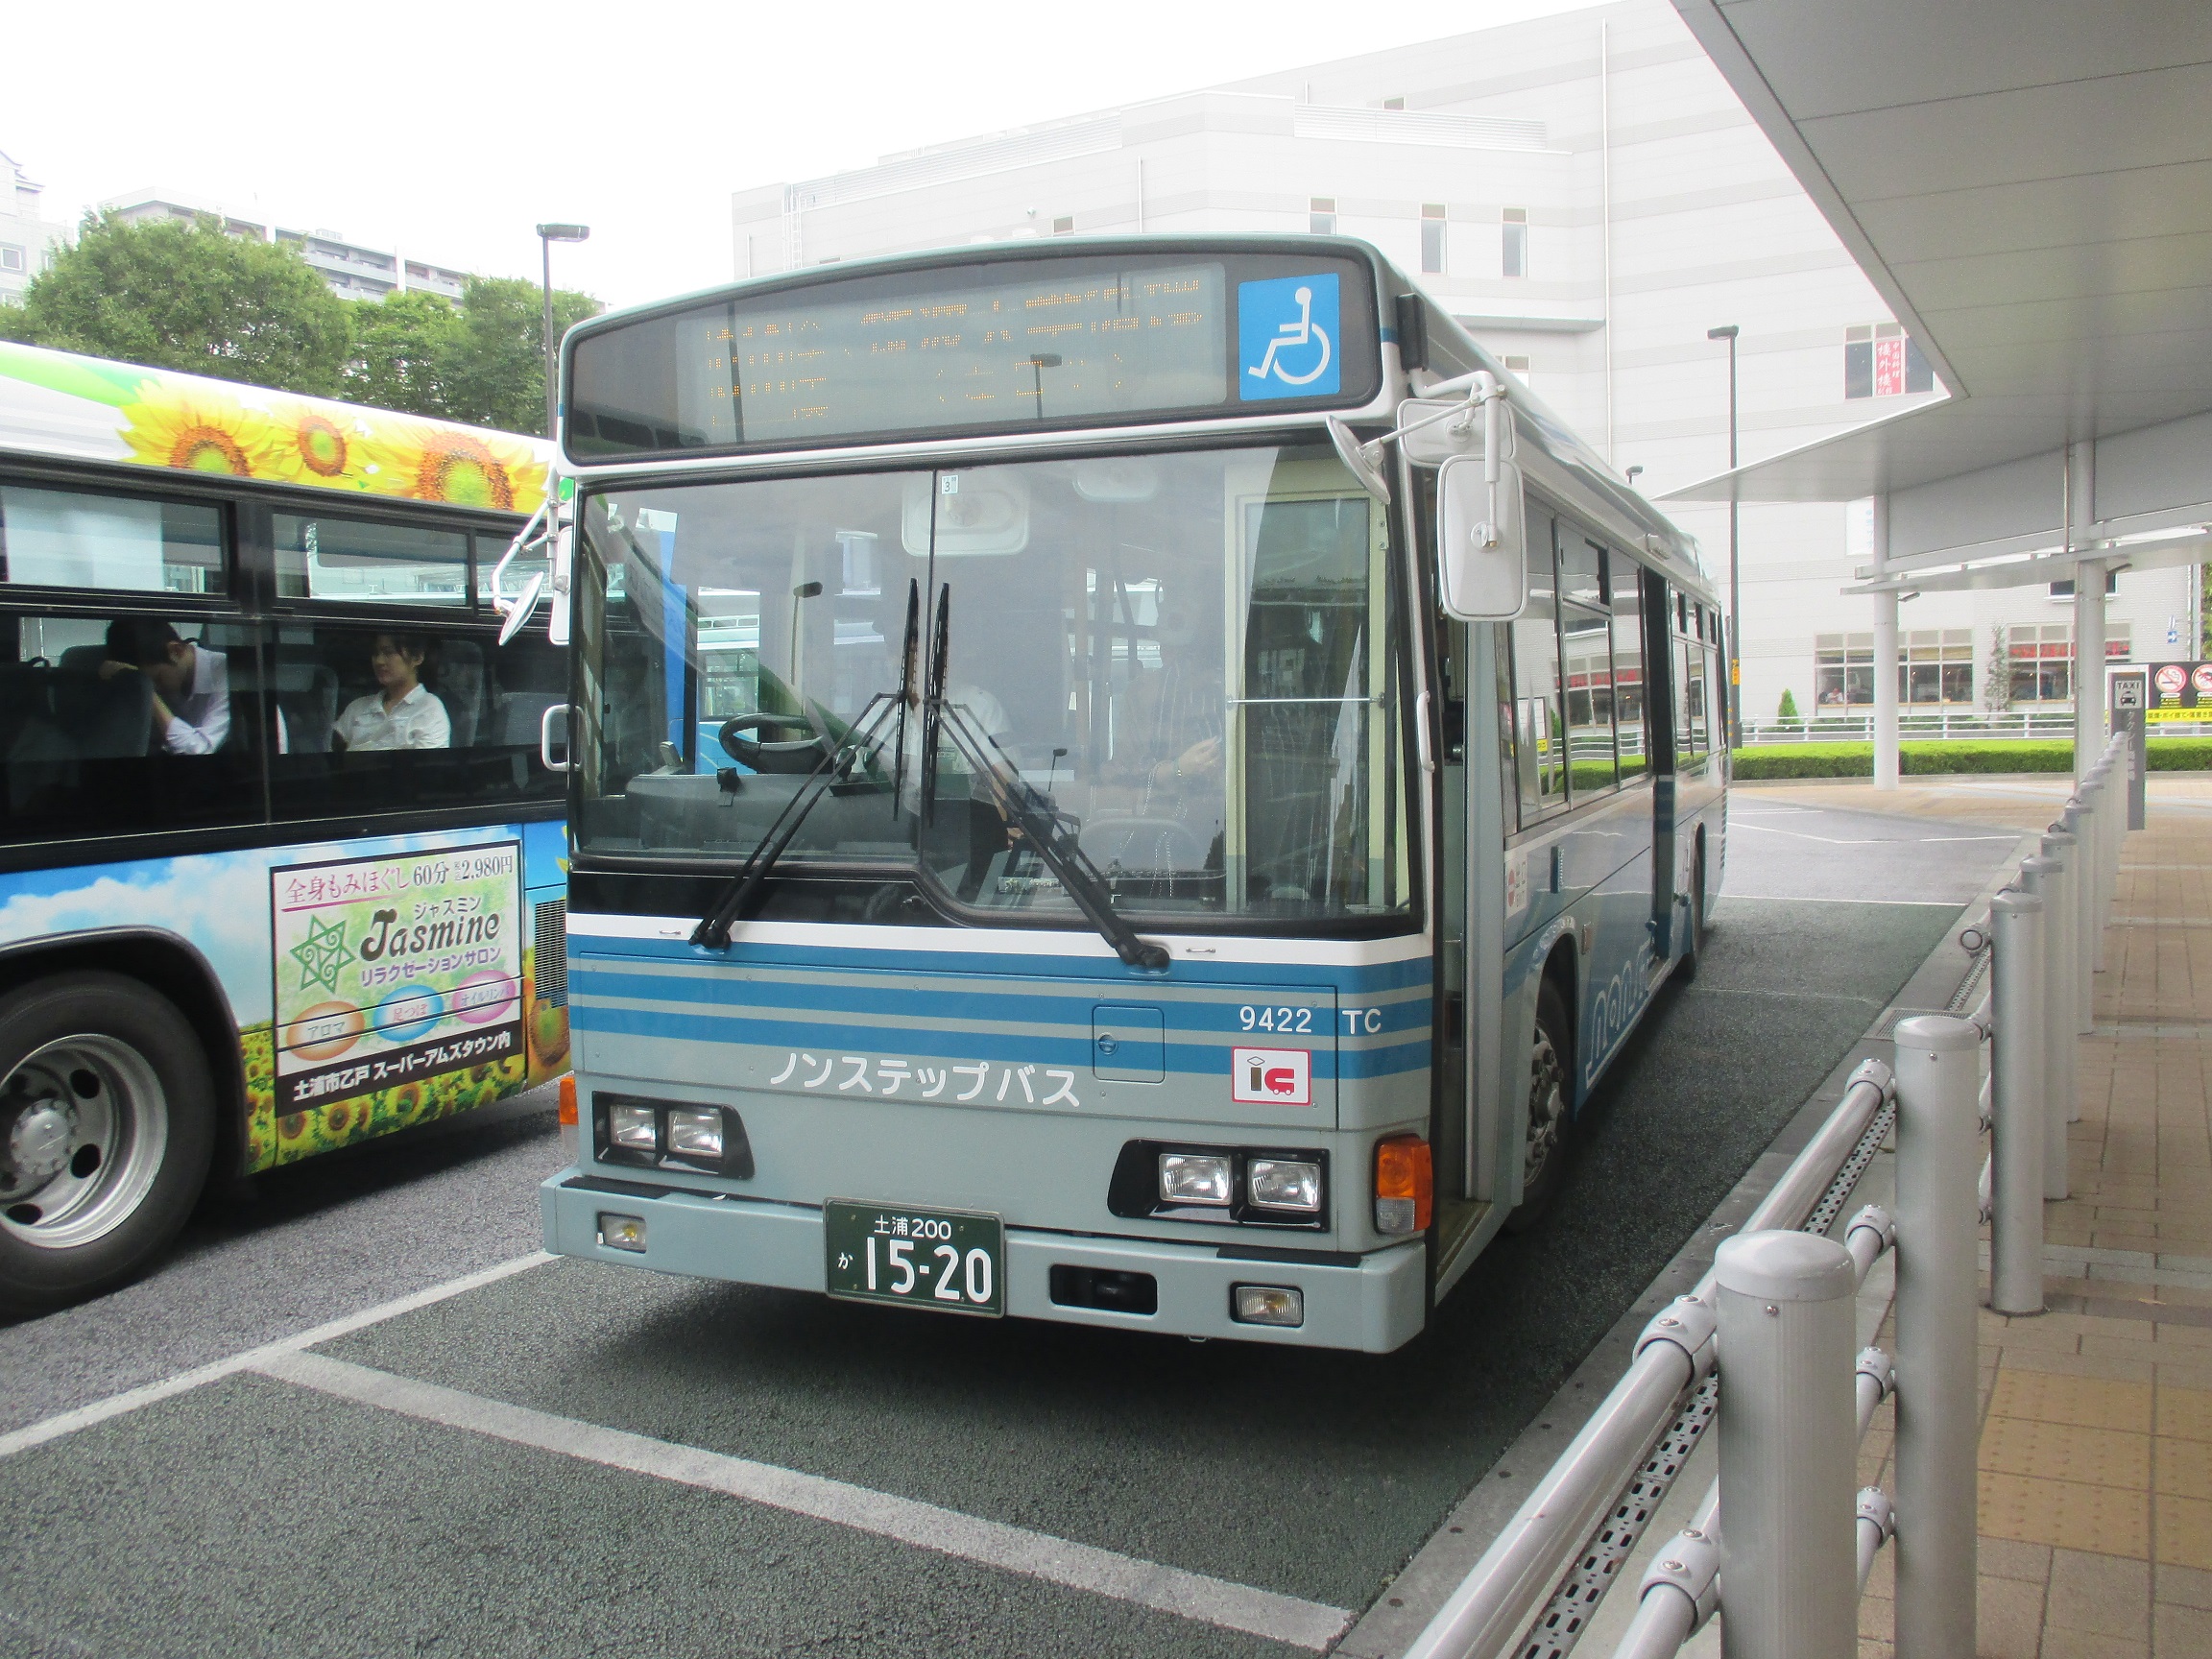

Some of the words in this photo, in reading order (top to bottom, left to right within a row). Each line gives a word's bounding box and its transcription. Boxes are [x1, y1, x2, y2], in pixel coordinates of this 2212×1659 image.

[286, 866, 411, 904] 全身もみほぐし
[413, 860, 450, 887] 60分
[414, 896, 482, 921] ジャスミン
[359, 907, 501, 962] Jasmine
[361, 947, 501, 987] リラクゼーションサロン
[307, 1021, 346, 1039] アロマ
[1238, 1005, 1312, 1034] 9422
[1341, 1007, 1382, 1035] TC
[293, 1065, 371, 1102] 土浦市乙戸
[770, 1052, 1080, 1108] ノンステップバス
[837, 1251, 854, 1270] か
[866, 1236, 993, 1304] 15-20
